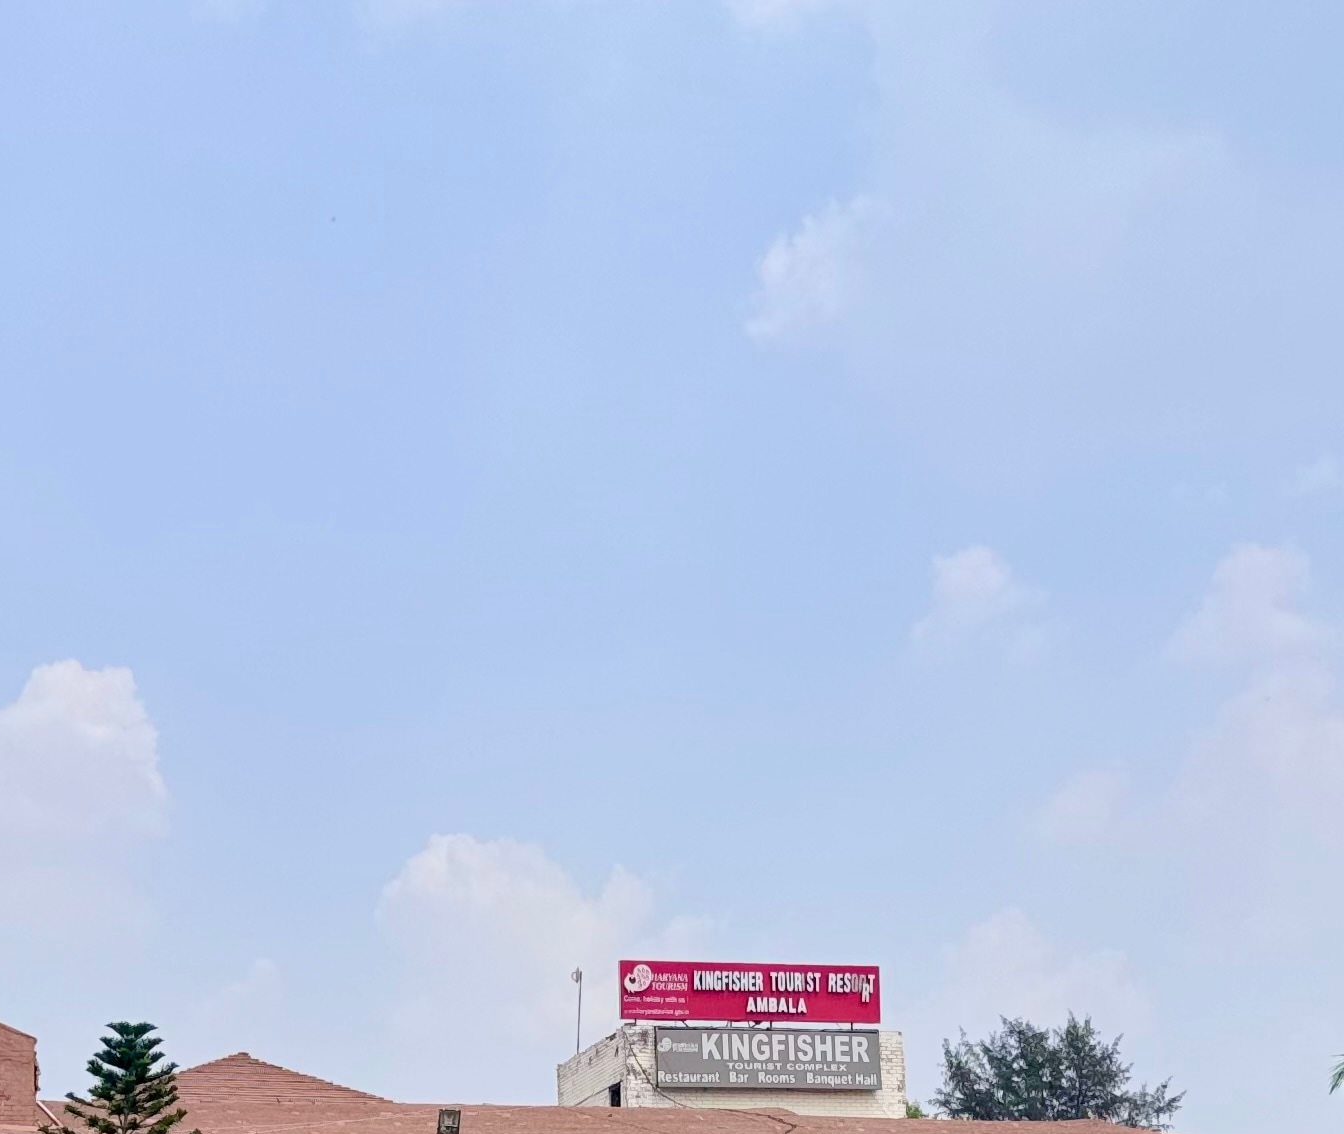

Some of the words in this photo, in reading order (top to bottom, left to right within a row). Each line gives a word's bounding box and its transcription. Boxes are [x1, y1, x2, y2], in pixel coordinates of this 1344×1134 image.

[651, 982, 688, 991] TOURISM
[693, 970, 763, 992] KINGFISHER
[770, 971, 821, 992] TOURIST
[746, 997, 807, 1013] AMBALA
[701, 1032, 870, 1062] KINGFISHER
[726, 1062, 782, 1070] TOURIST
[786, 1062, 847, 1071] COMPLEX
[658, 1070, 720, 1083] Restaurant
[729, 1071, 748, 1083] Bar
[758, 1072, 795, 1084] Rooms
[807, 1072, 852, 1087] Banquet
[855, 1073, 877, 1085] Hall
